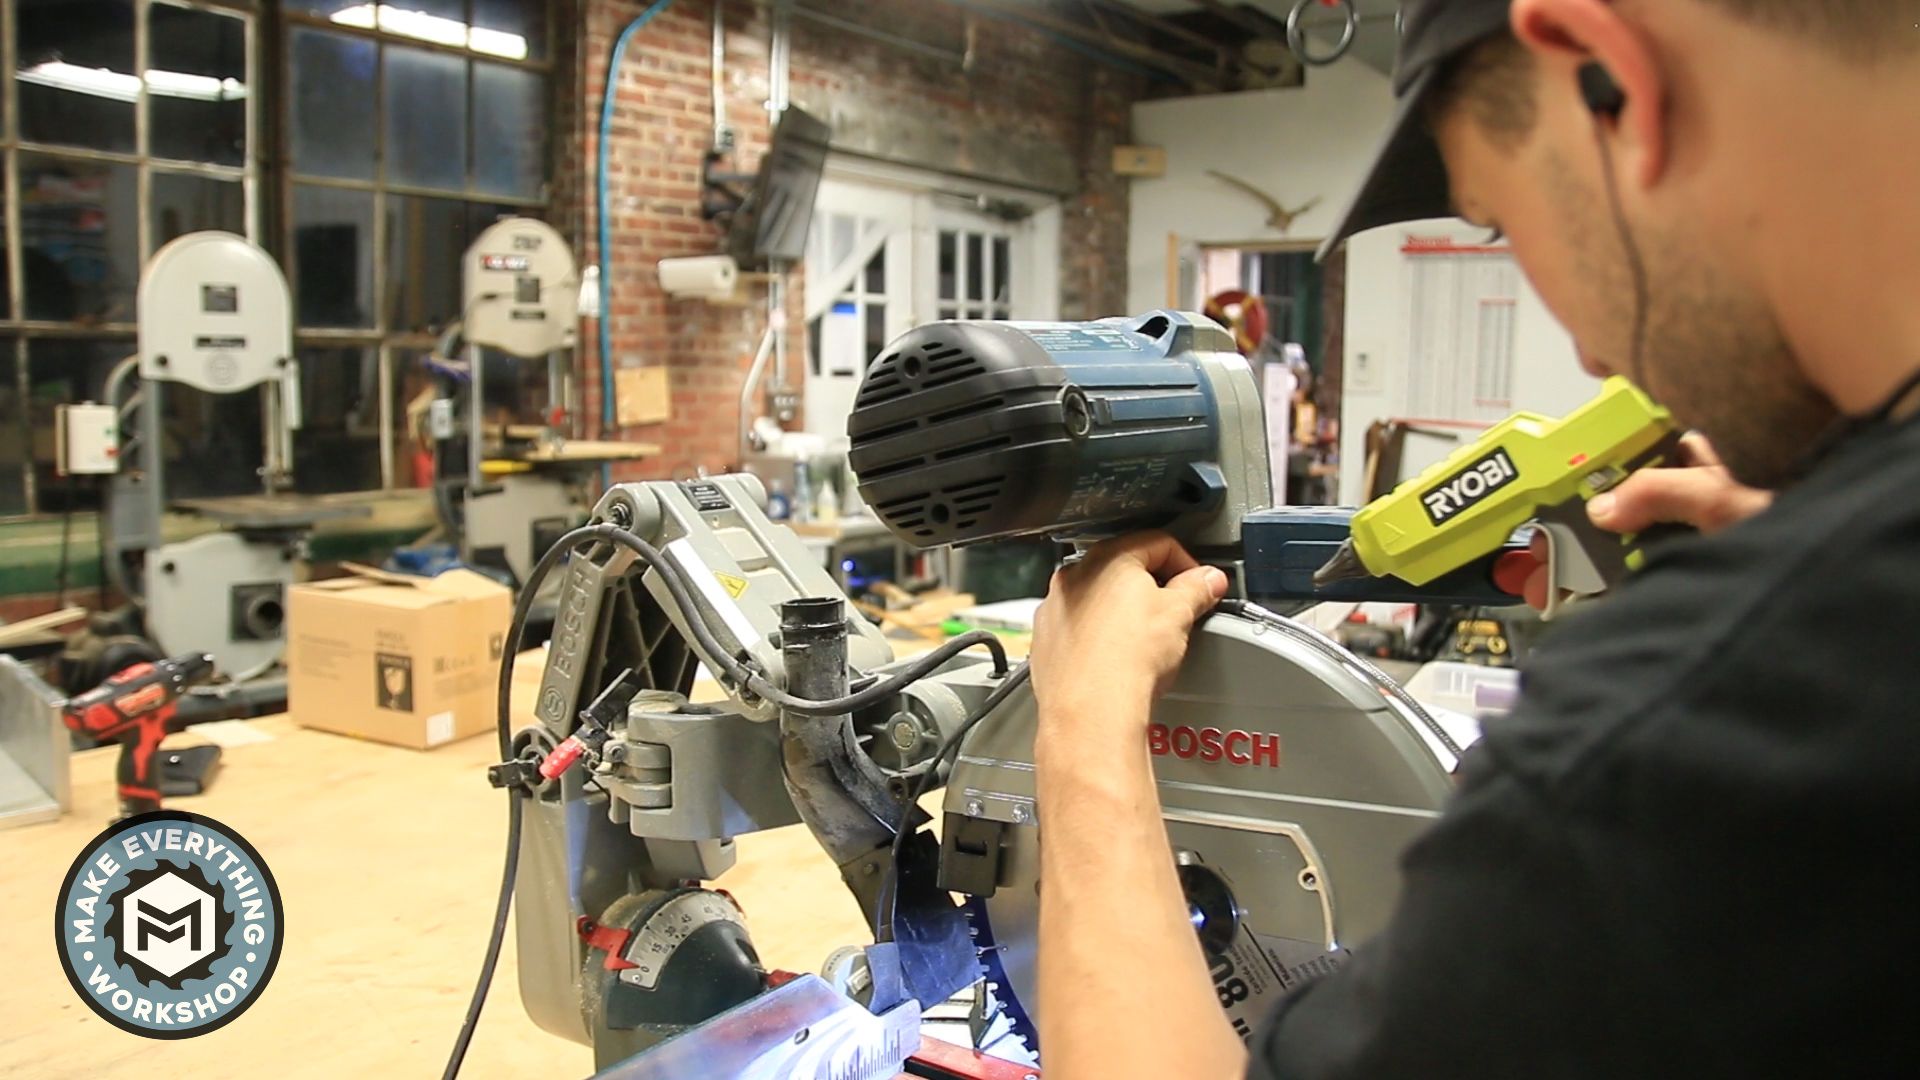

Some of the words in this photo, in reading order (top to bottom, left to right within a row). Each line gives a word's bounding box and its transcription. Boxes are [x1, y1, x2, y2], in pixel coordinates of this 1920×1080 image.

[1423, 453, 1514, 520] RYOBI
[554, 570, 593, 680] BOSCH
[1148, 723, 1280, 768] BOSCH
[651, 942, 663, 954] 15
